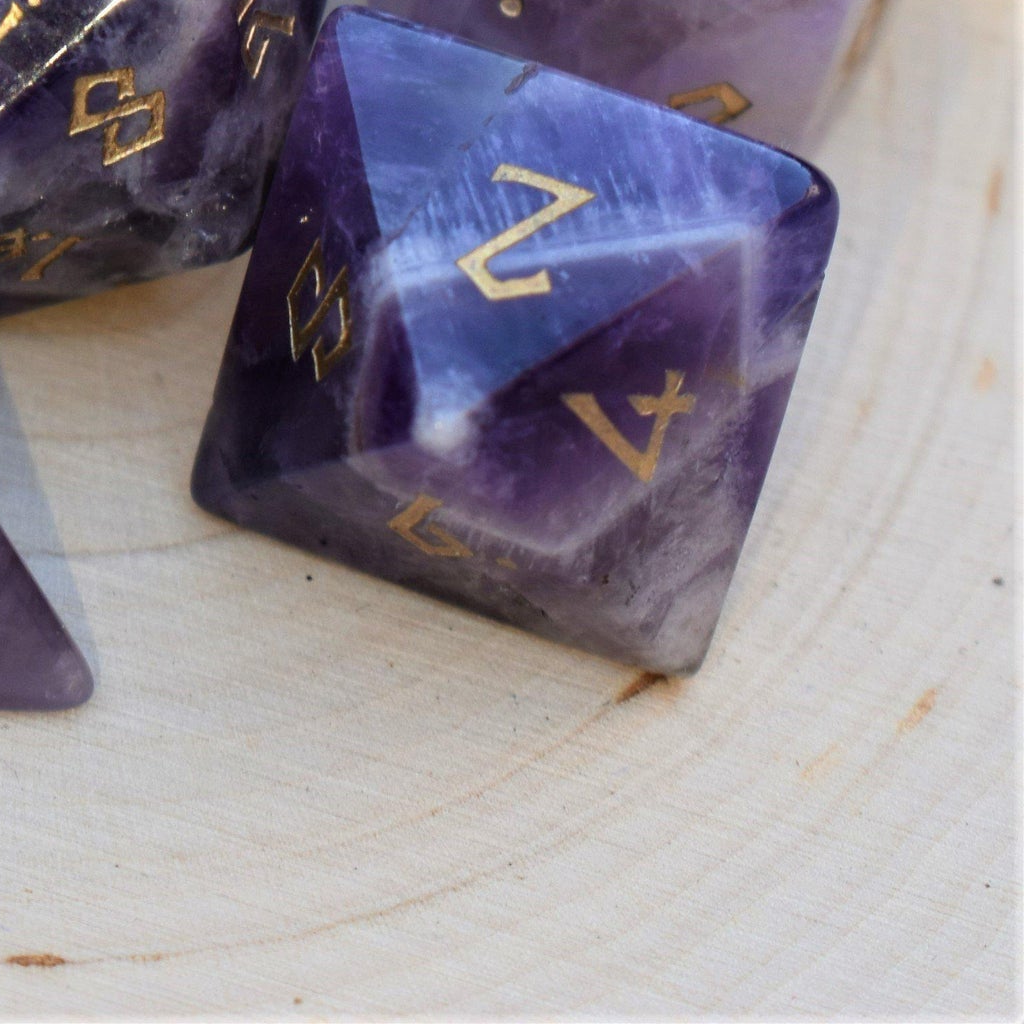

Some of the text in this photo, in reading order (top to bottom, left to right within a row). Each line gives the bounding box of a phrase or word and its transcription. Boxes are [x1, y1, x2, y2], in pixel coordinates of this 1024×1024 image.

[68, 68, 166, 167] 8
[455, 162, 596, 301] 2
[287, 237, 352, 382] 8
[560, 370, 697, 481] 4
